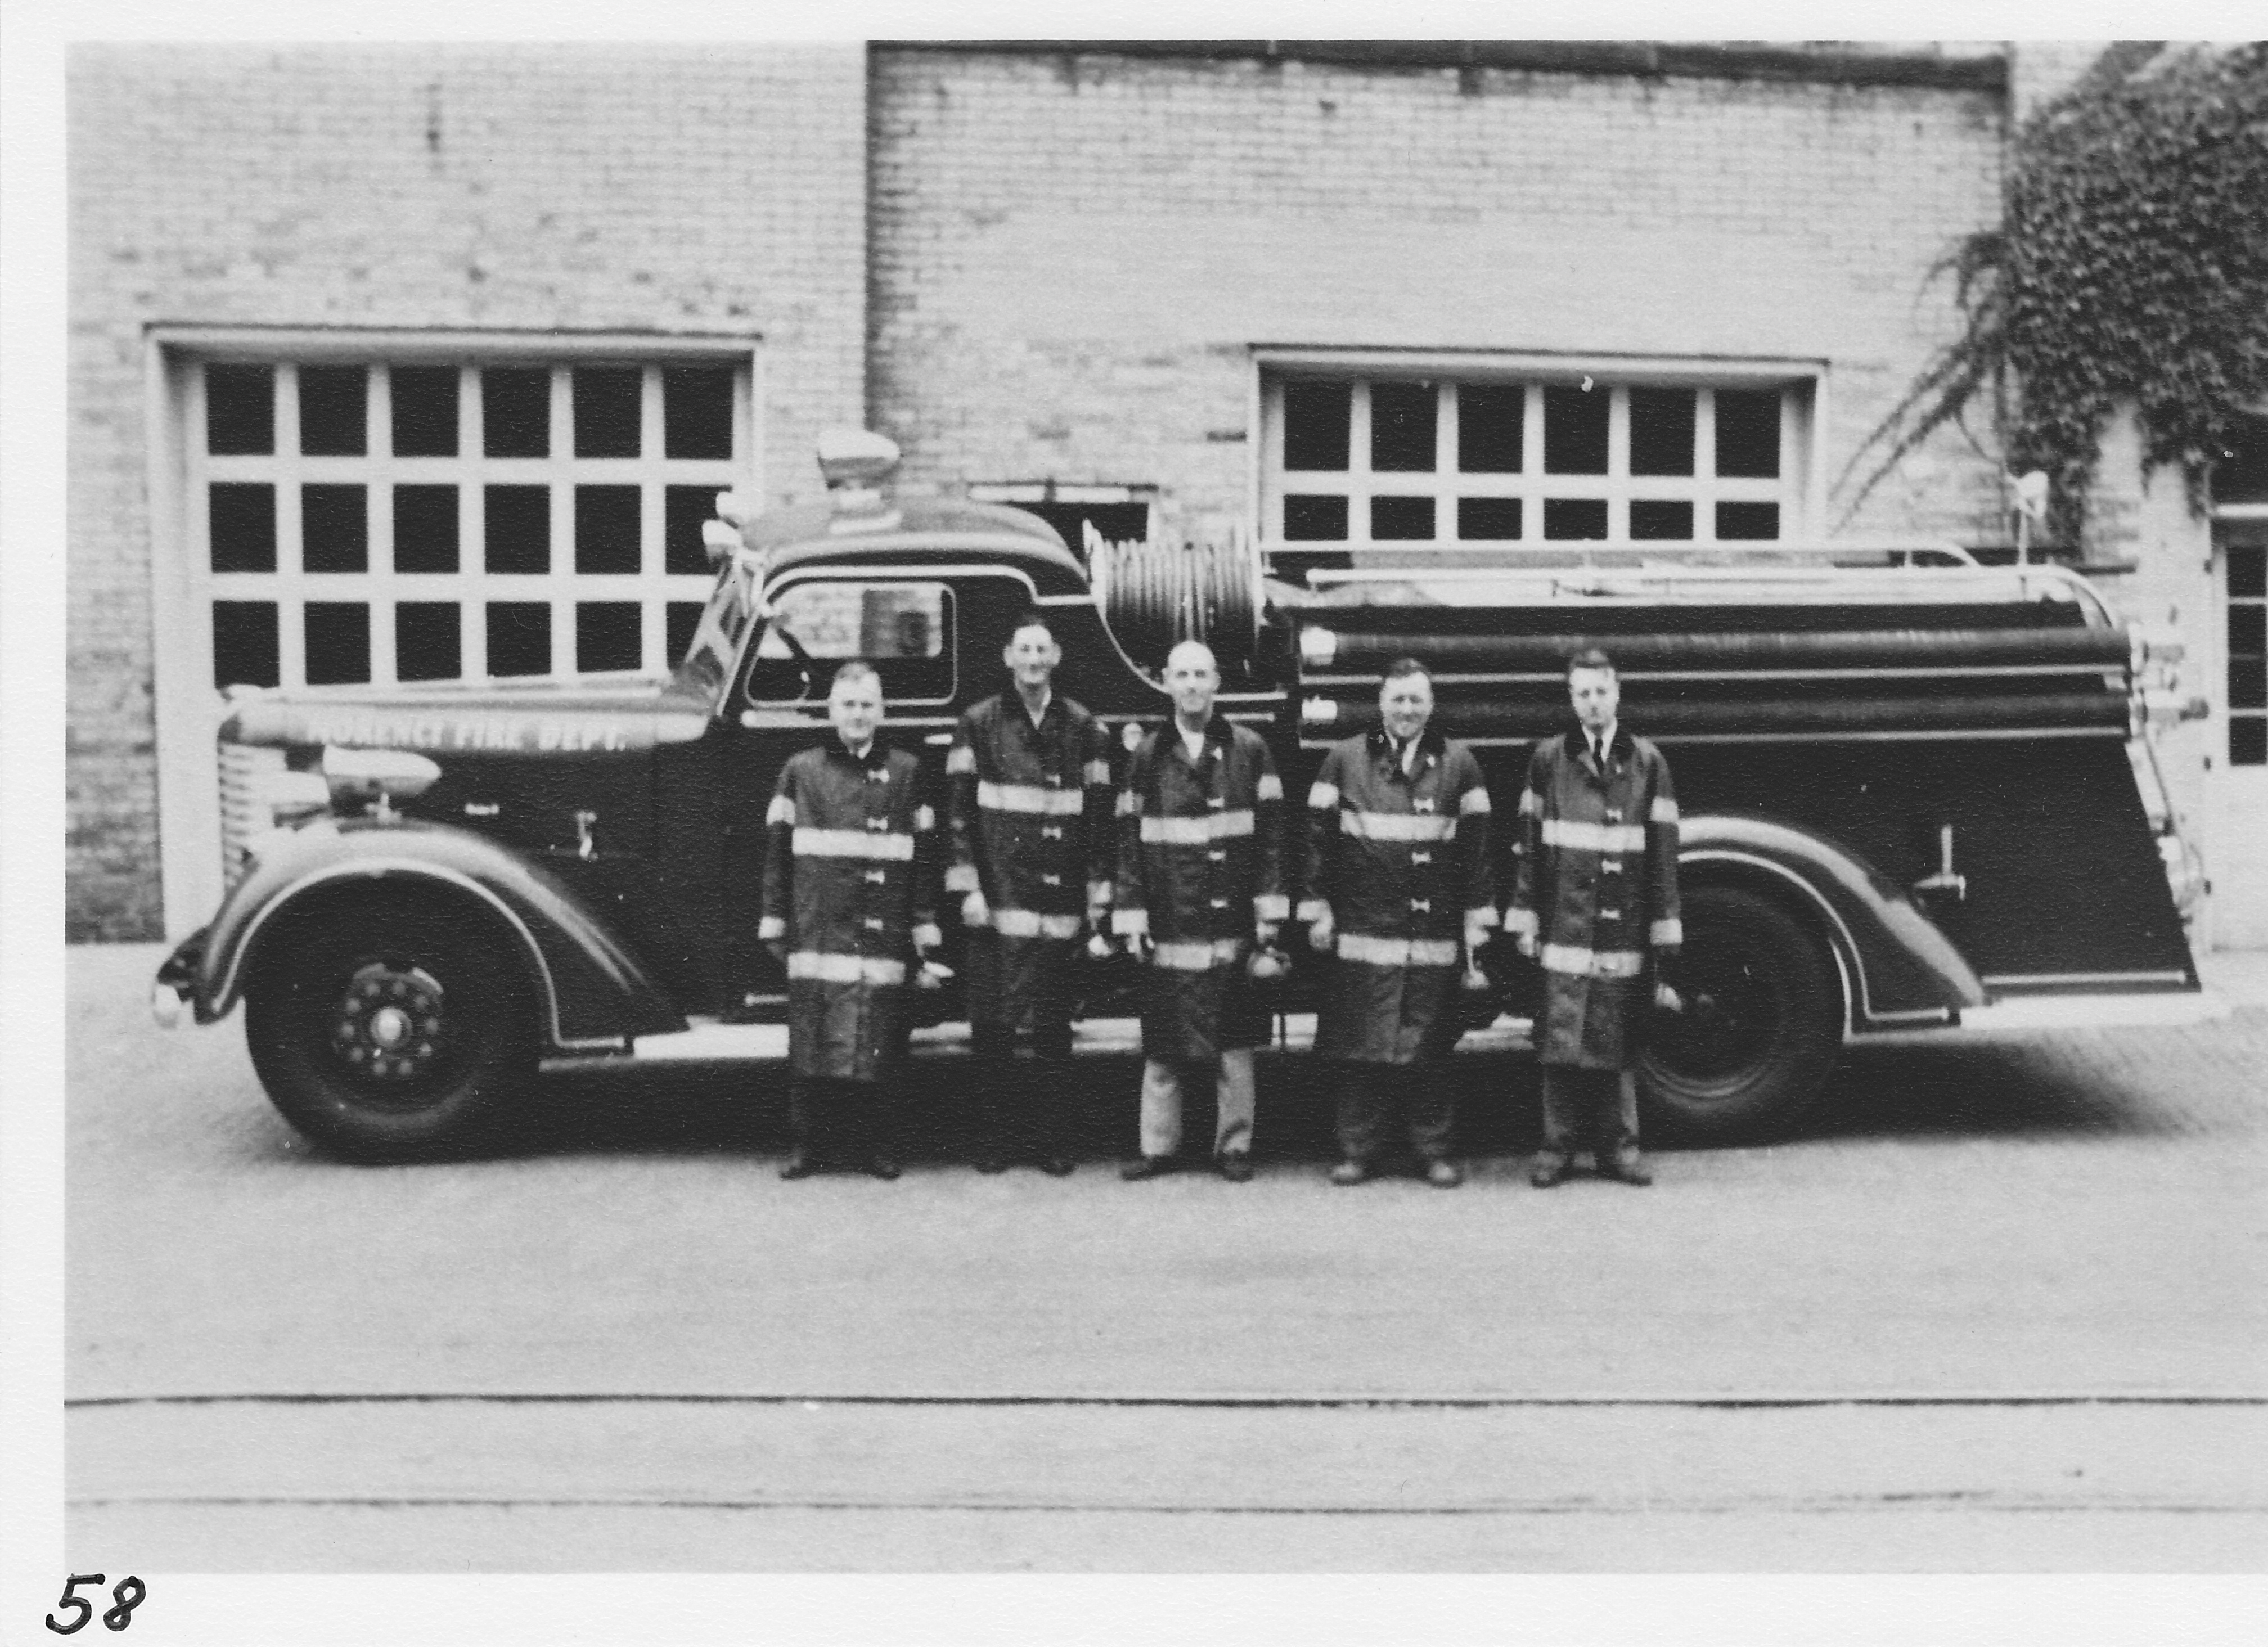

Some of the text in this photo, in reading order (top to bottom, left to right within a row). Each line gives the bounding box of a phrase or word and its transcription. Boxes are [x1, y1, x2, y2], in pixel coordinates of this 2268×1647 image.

[454, 720, 523, 749] FIRE
[538, 722, 626, 752] DEPT.
[46, 1573, 146, 1635] 58
